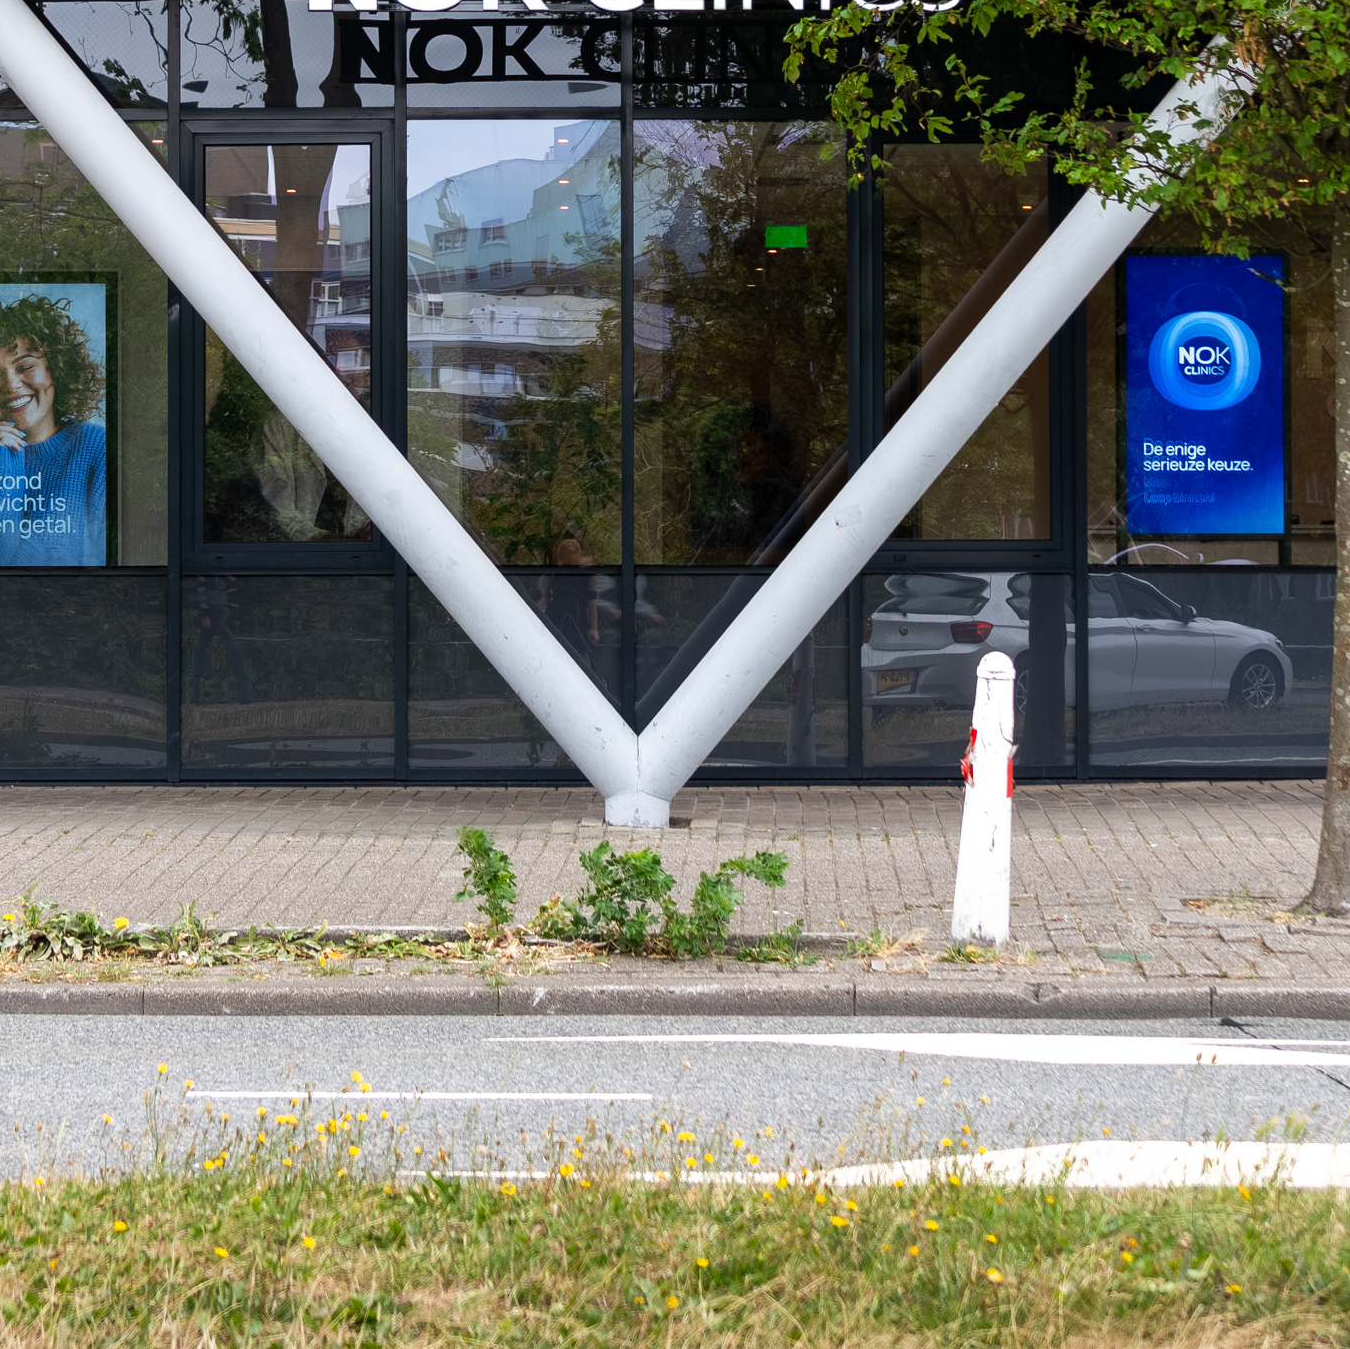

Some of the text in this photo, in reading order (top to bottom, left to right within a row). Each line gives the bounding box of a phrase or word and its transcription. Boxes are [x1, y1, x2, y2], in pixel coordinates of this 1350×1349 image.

[1178, 346, 1231, 365] NOK
[1184, 365, 1225, 375] CLINICS
[1143, 442, 1206, 460] De enige
[1143, 457, 1254, 471] serieuze keuze.
[50, 493, 67, 512] is
[19, 515, 76, 539] getal.
